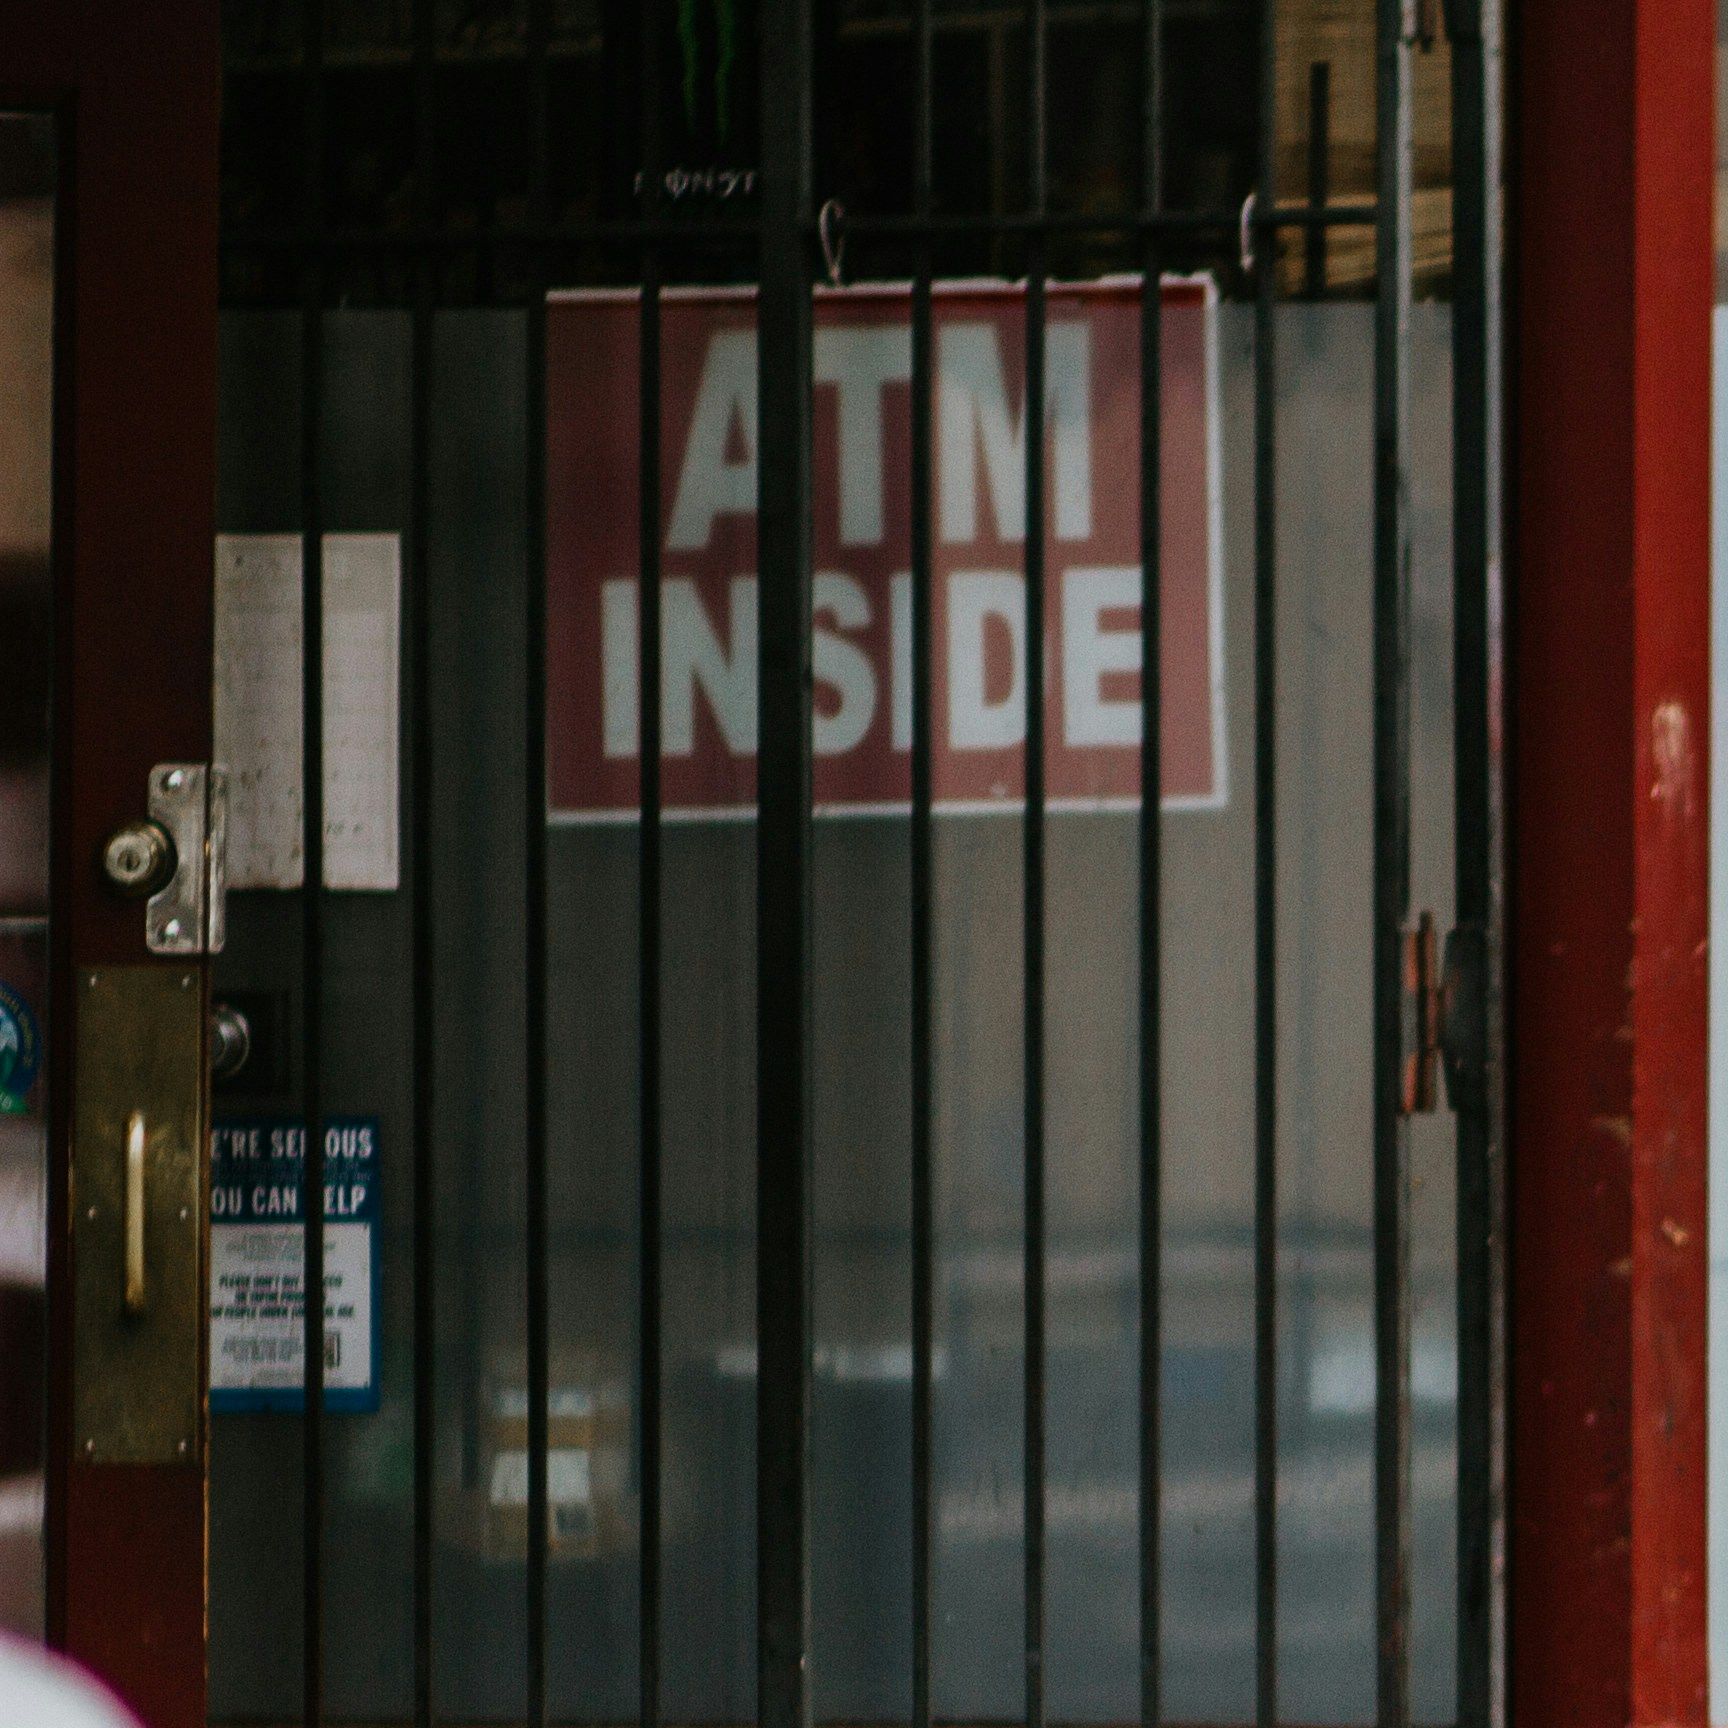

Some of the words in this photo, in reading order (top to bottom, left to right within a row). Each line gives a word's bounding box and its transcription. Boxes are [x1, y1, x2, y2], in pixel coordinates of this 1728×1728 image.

[667, 320, 1091, 551] ATM
[603, 564, 1143, 758] INSIDE
[211, 1127, 261, 1161] E'RE
[271, 1126, 373, 1160] SEOUS
[211, 1185, 242, 1216] OU
[252, 1185, 298, 1216] CAN
[323, 1184, 367, 1216] ELP
